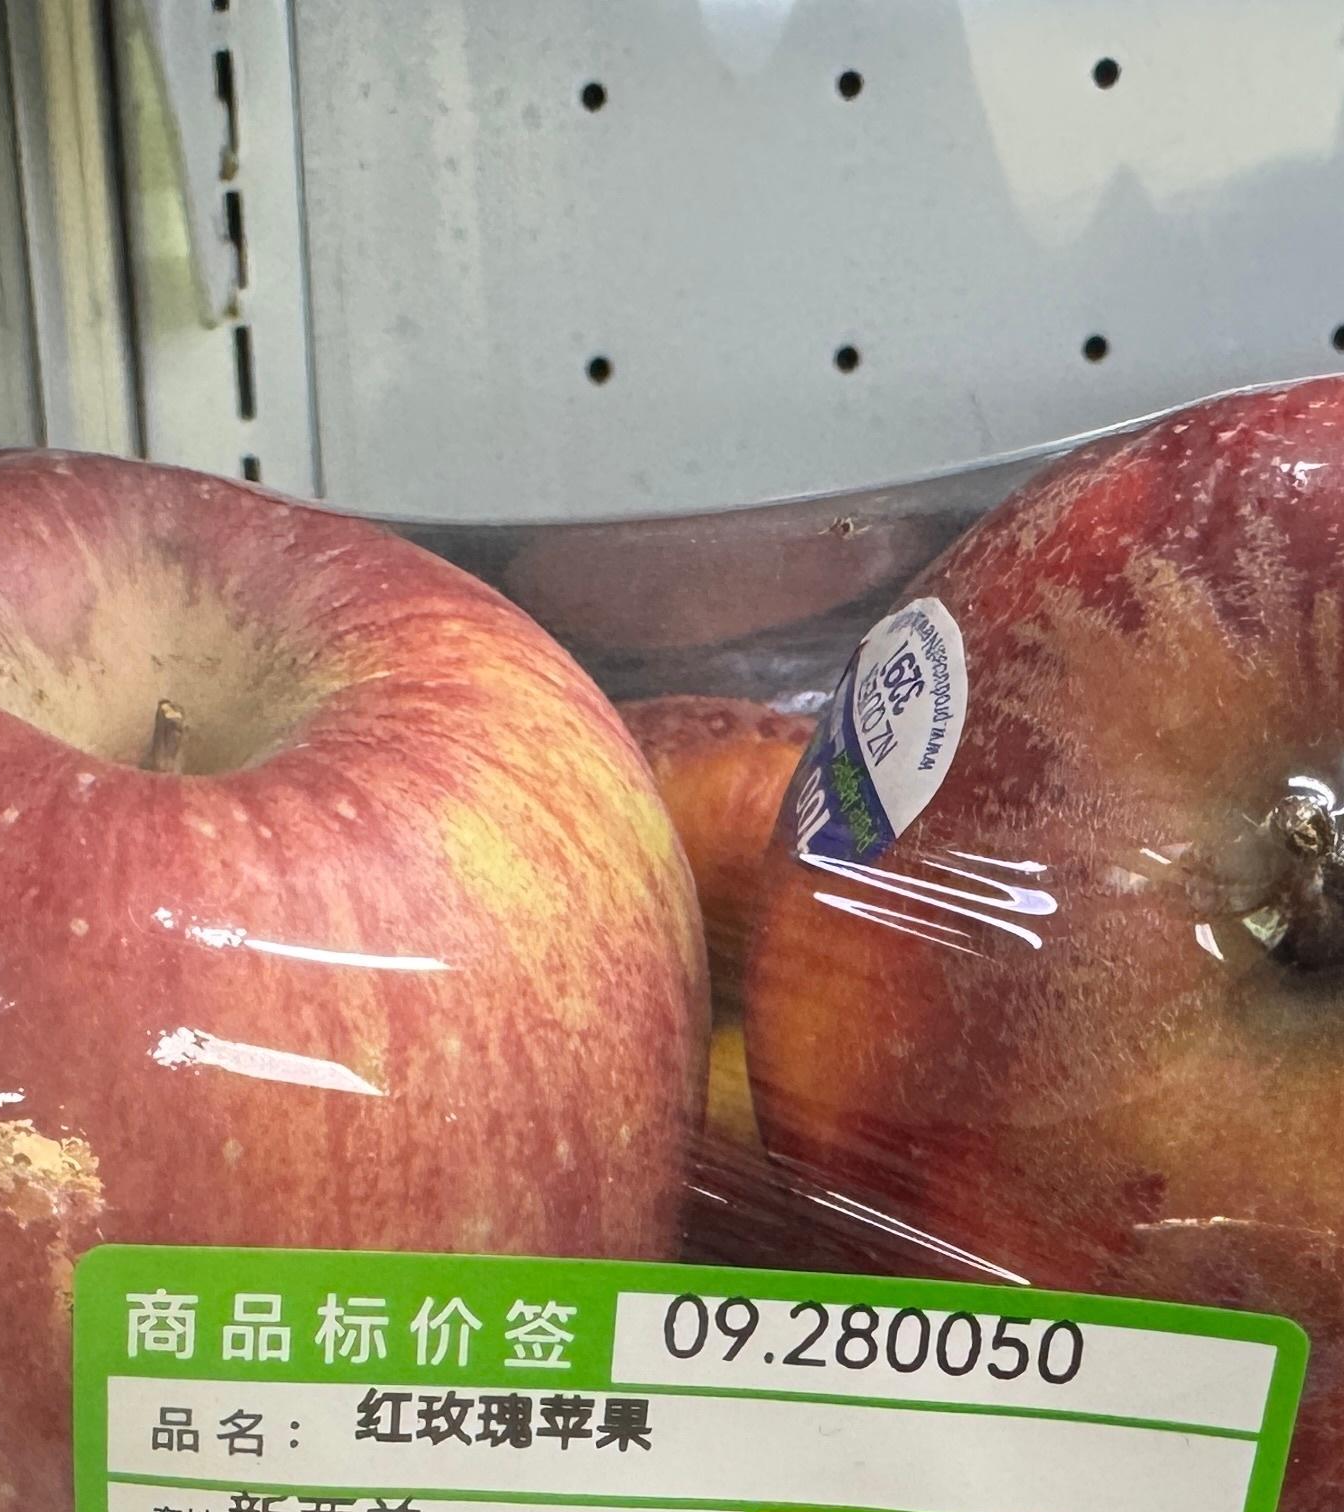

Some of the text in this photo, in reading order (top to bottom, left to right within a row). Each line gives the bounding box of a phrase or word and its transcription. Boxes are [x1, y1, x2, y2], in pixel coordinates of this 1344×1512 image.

[868, 719, 898, 768] NZ
[126, 1288, 578, 1369] 商品标价签
[663, 1292, 1084, 1385] 09.280050
[151, 1387, 654, 1458] 品名： 红玫瑰苹果
